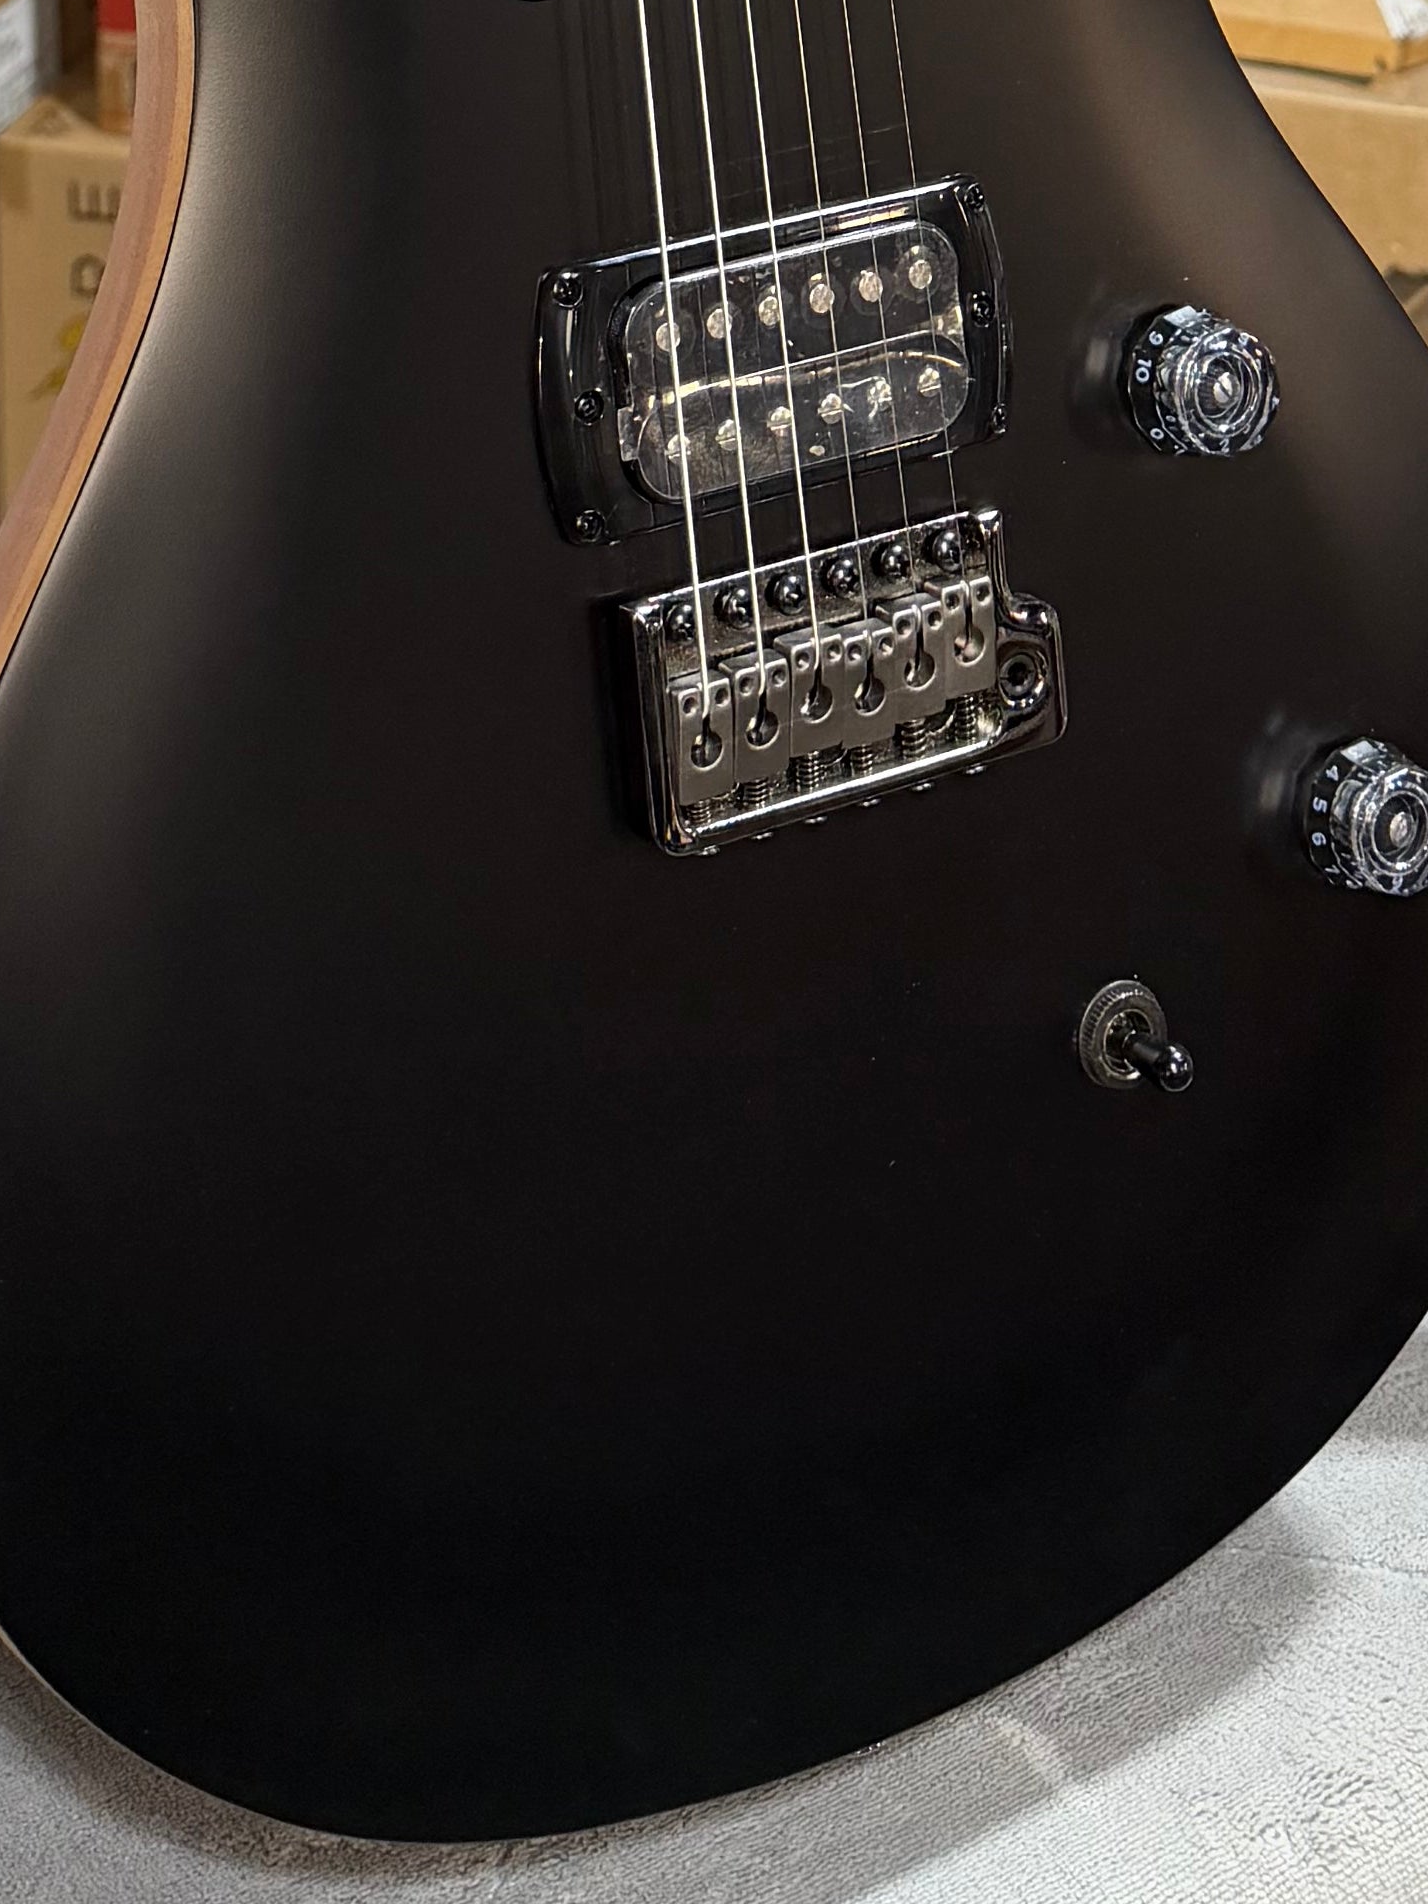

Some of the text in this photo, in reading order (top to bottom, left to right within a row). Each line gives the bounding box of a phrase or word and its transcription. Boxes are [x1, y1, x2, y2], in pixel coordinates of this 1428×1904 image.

[1135, 358, 1153, 383] 10
[1312, 796, 1328, 814] 5
[1311, 831, 1327, 847] 6
